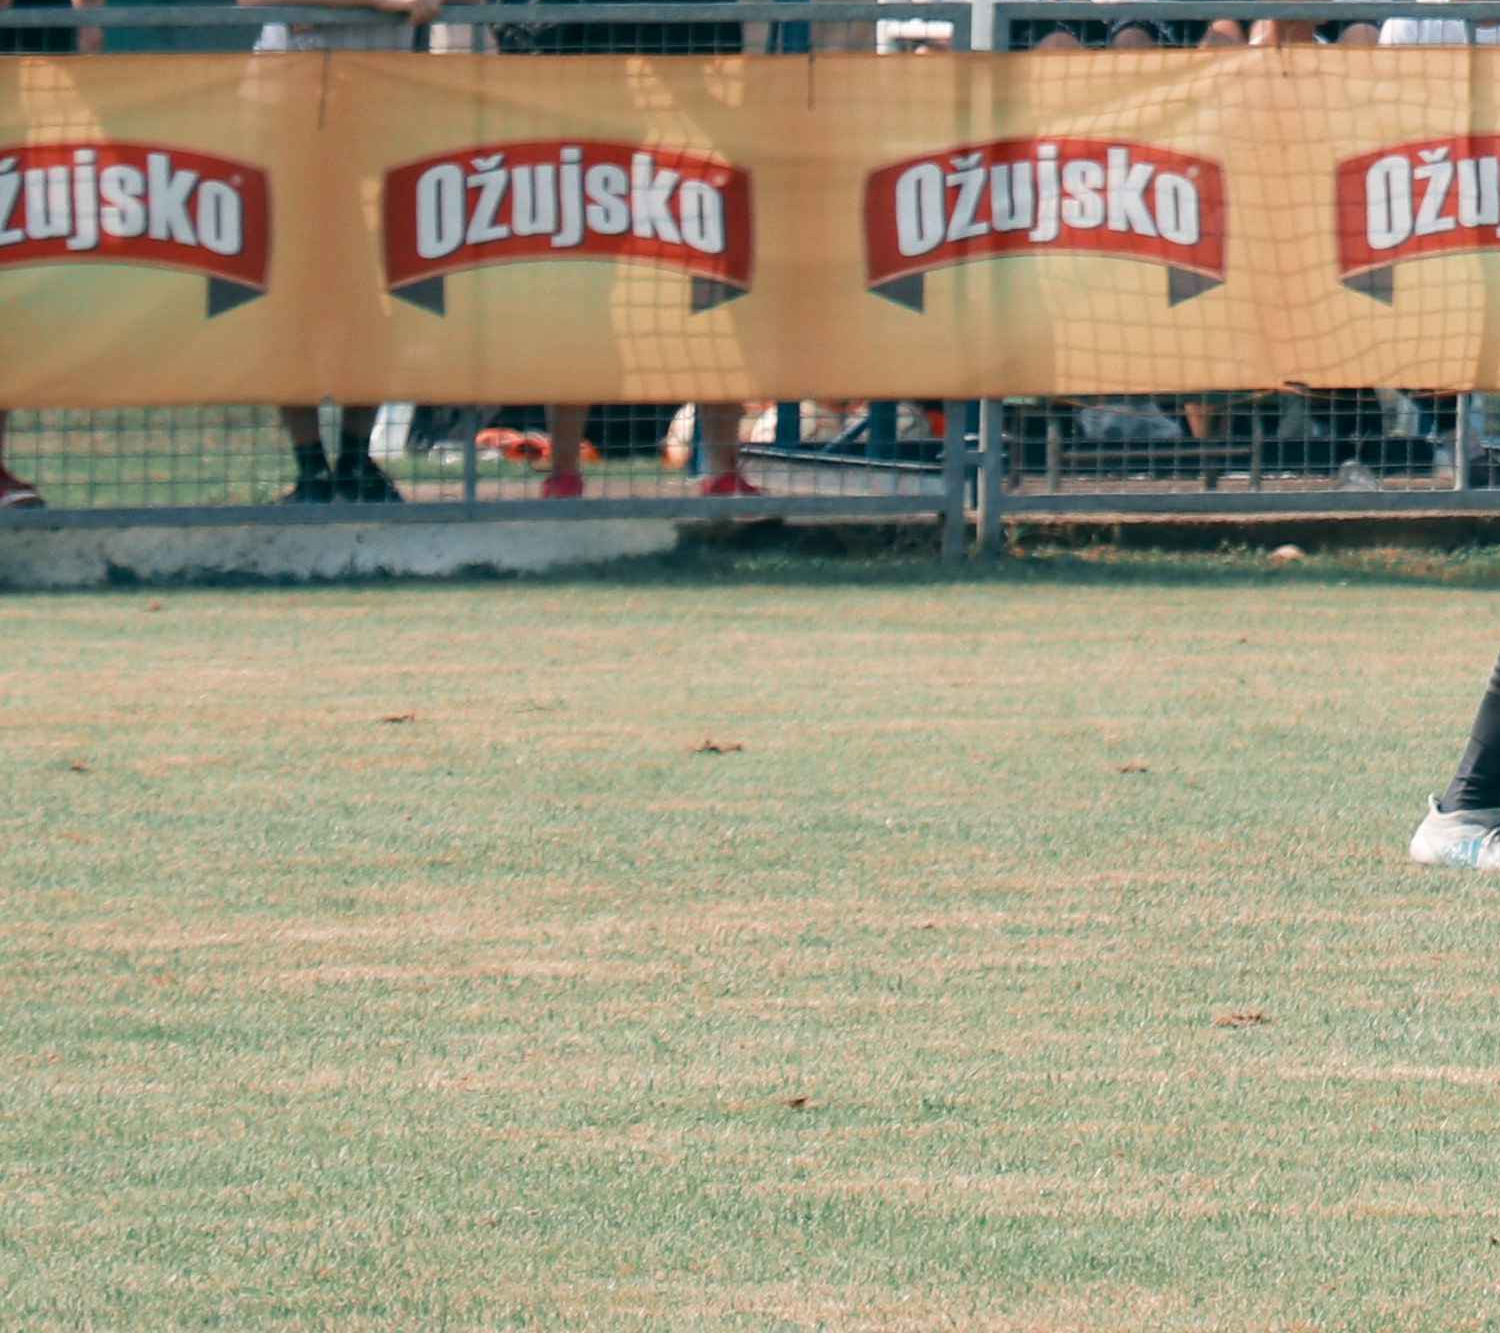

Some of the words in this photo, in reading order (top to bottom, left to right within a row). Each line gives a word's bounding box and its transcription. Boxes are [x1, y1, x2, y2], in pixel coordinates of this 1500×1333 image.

[0, 148, 243, 256] žujsko
[415, 147, 725, 259] Ožujsko
[895, 144, 1199, 258] Ožujsko
